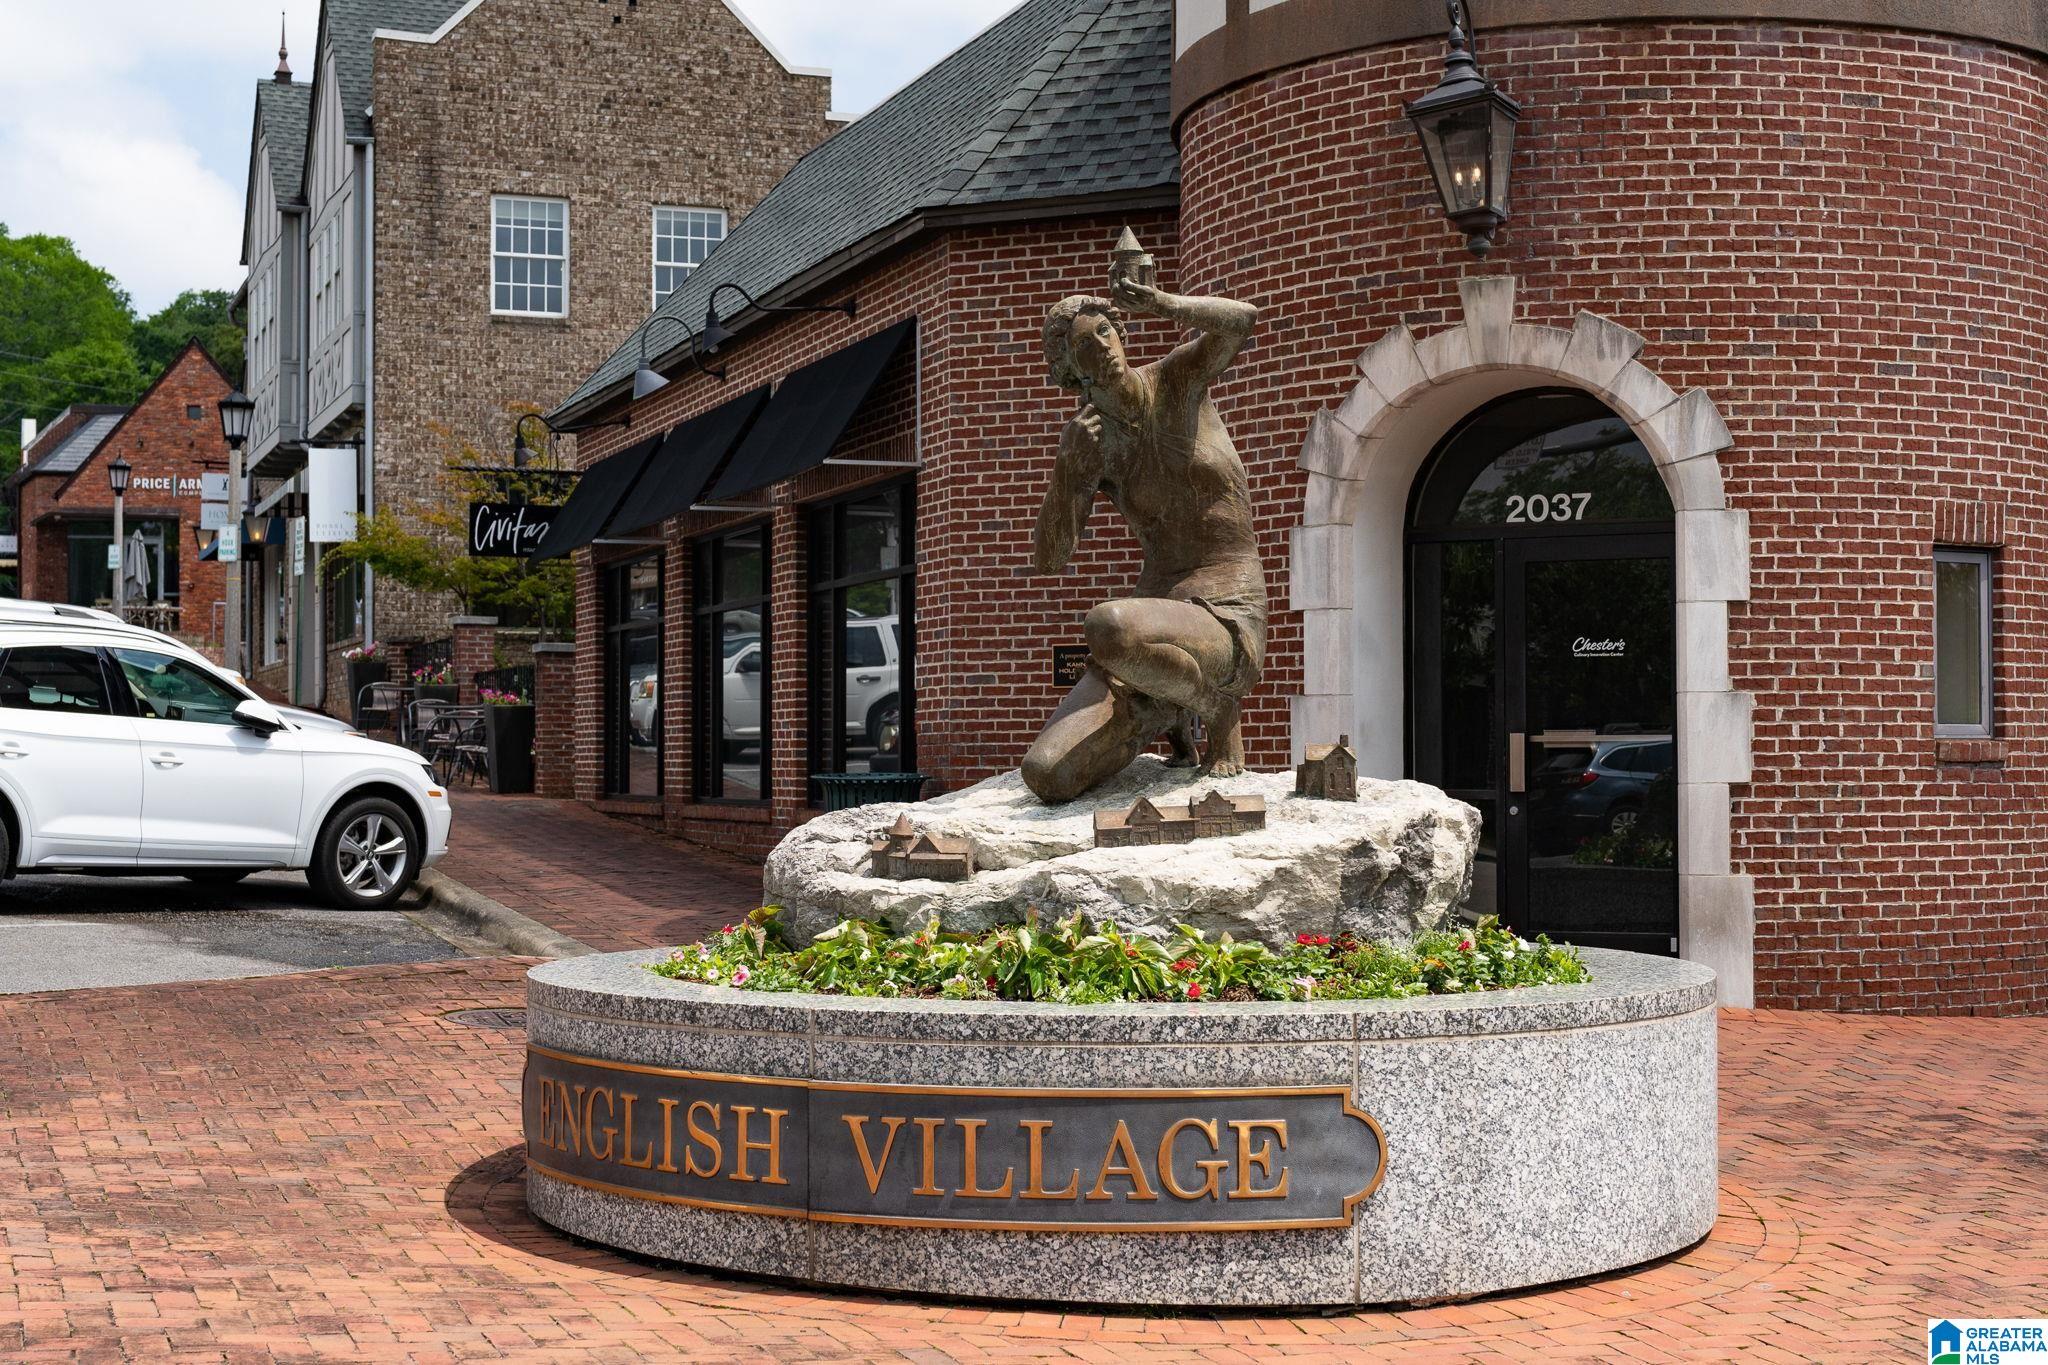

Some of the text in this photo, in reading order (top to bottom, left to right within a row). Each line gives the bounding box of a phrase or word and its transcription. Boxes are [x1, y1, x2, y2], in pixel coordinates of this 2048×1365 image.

[133, 478, 171, 489] PRICE
[1506, 492, 1592, 523] 2037
[1572, 636, 1626, 652] Chester's
[538, 1076, 1290, 1201] ENGLISH VILLAGE
